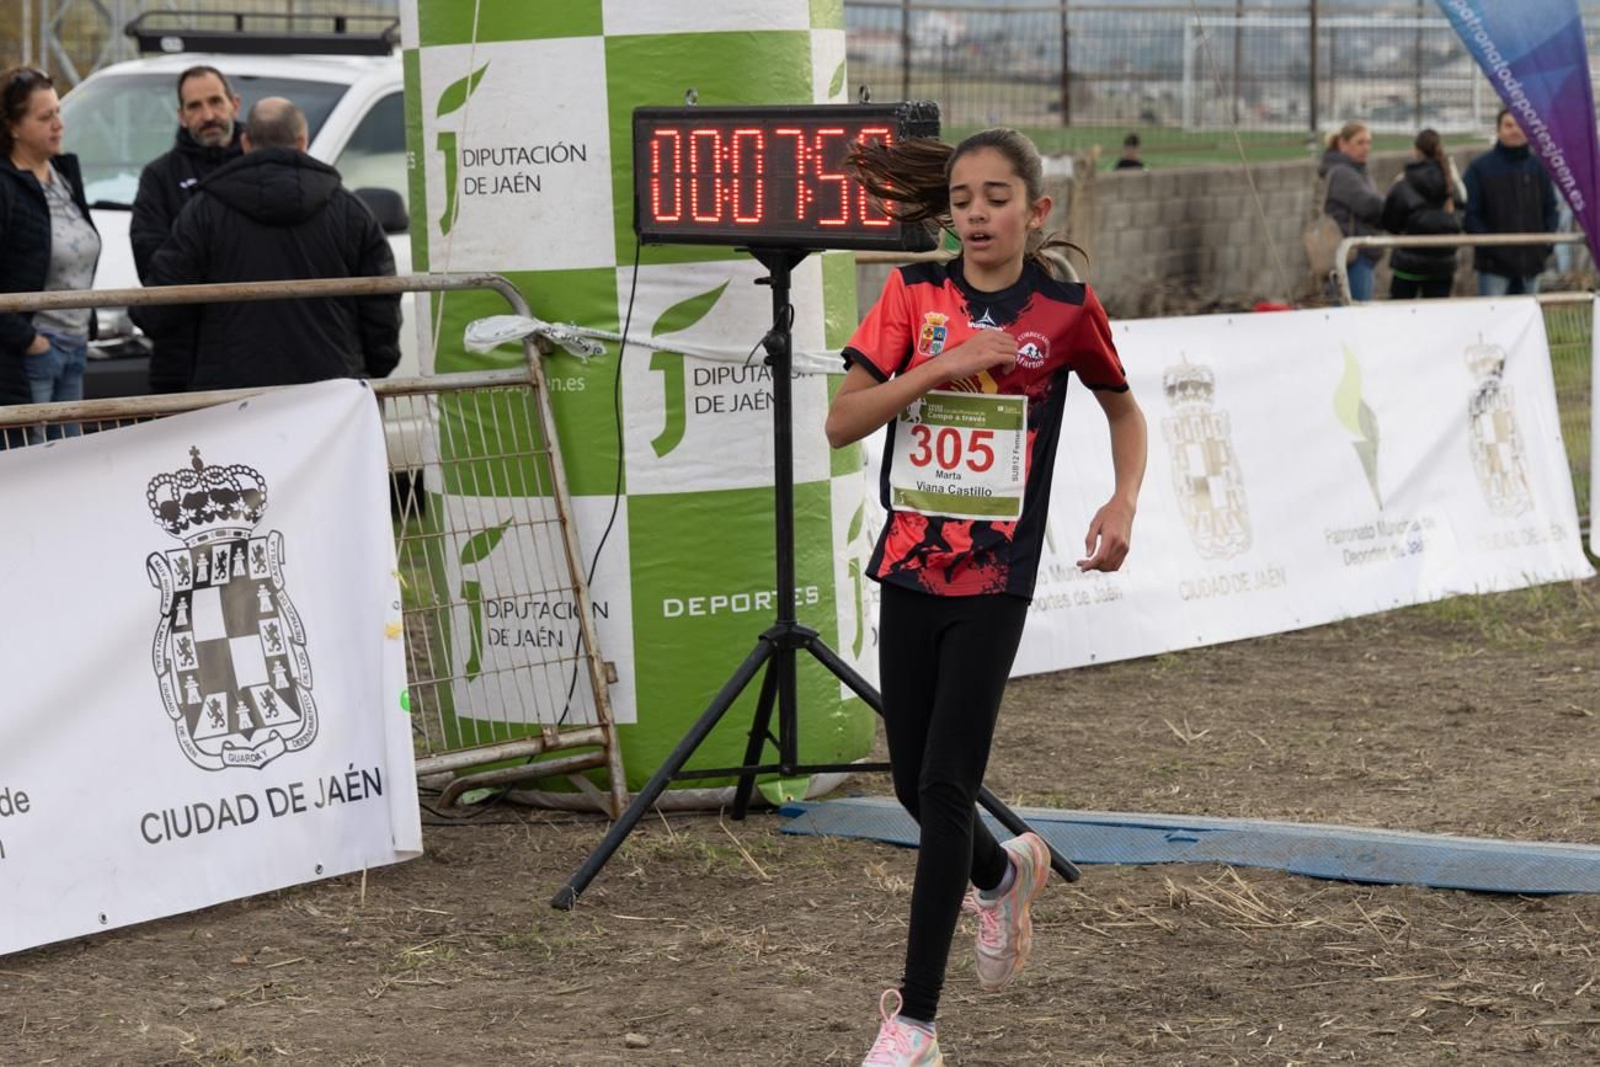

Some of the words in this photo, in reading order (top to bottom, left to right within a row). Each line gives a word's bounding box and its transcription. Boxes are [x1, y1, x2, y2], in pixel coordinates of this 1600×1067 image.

[462, 141, 588, 167] DIPUTACIÓN
[464, 177, 488, 195] DE
[491, 172, 541, 194] JAÉN
[695, 395, 725, 414] DE
[909, 424, 995, 473] 305
[935, 469, 962, 480] Marta
[916, 481, 945, 493] Viana
[948, 484, 993, 497] Castillo
[488, 628, 509, 646] DE
[514, 626, 563, 648] JAÉN
[0, 787, 30, 817] de
[140, 793, 260, 845] CIUDAD
[265, 781, 308, 818] DE
[314, 763, 383, 810] JAÉN
